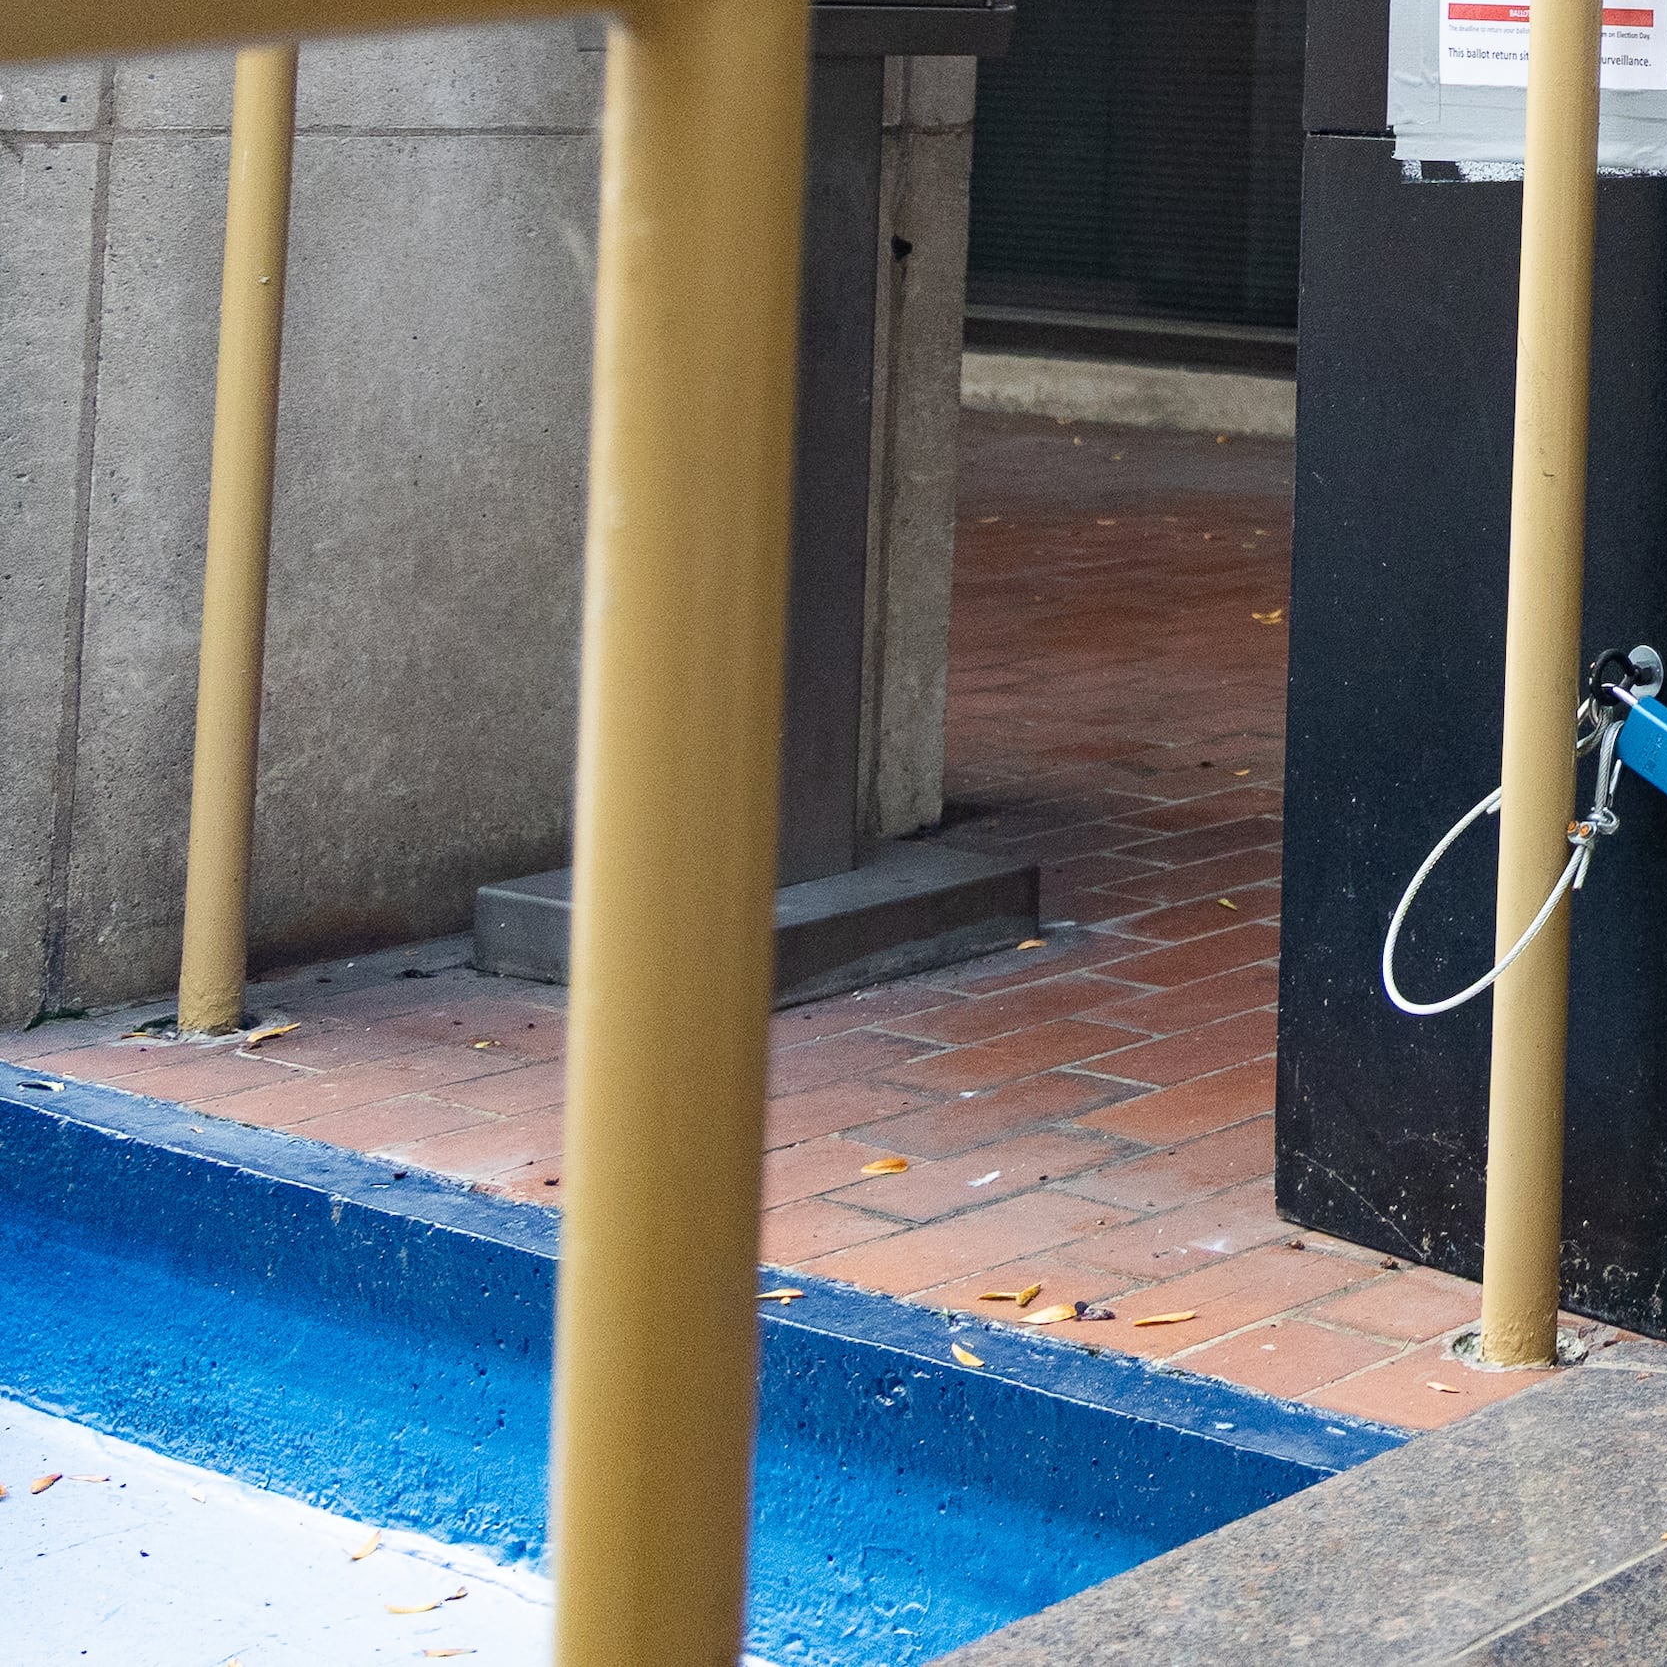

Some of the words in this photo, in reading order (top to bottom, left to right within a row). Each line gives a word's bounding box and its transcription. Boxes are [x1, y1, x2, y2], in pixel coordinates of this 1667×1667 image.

[1448, 47, 1465, 58] This
[1467, 48, 1489, 59] ballot
[1492, 50, 1517, 60] return
[1601, 54, 1652, 67] urveillance.
